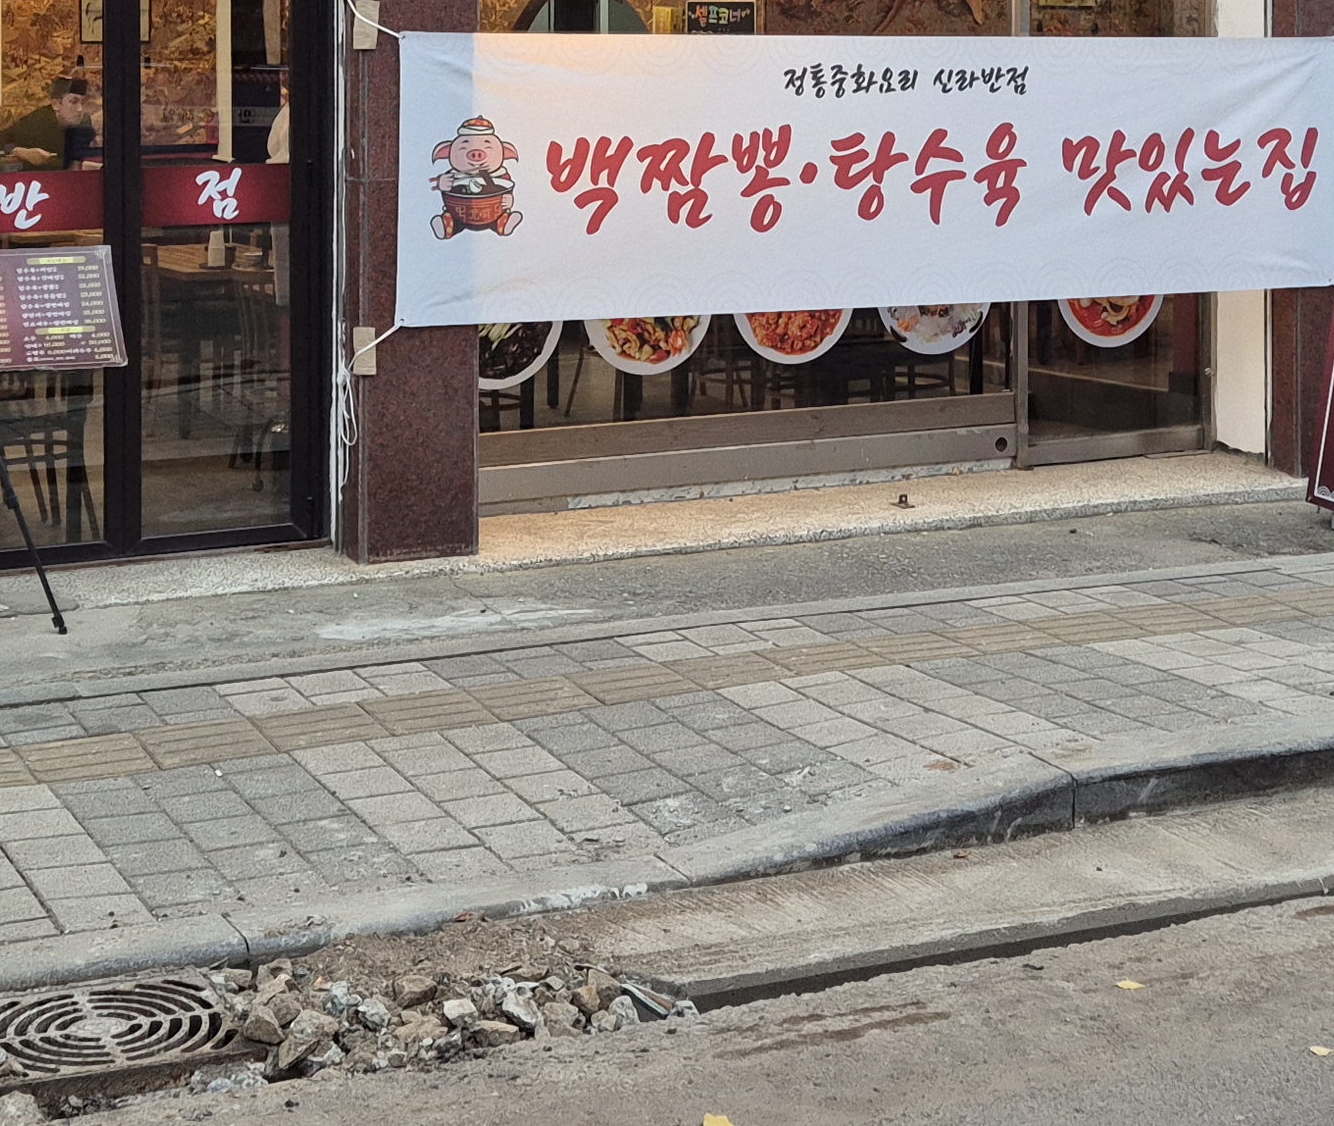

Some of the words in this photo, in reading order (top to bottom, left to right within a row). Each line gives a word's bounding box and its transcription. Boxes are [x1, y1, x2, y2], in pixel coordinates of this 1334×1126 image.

[695, 5, 741, 27] 셀프코너
[783, 63, 918, 99] 정통중화요리
[932, 65, 1030, 96] 신라반점
[1061, 126, 1319, 216] 맛있는집
[195, 167, 244, 220] 점
